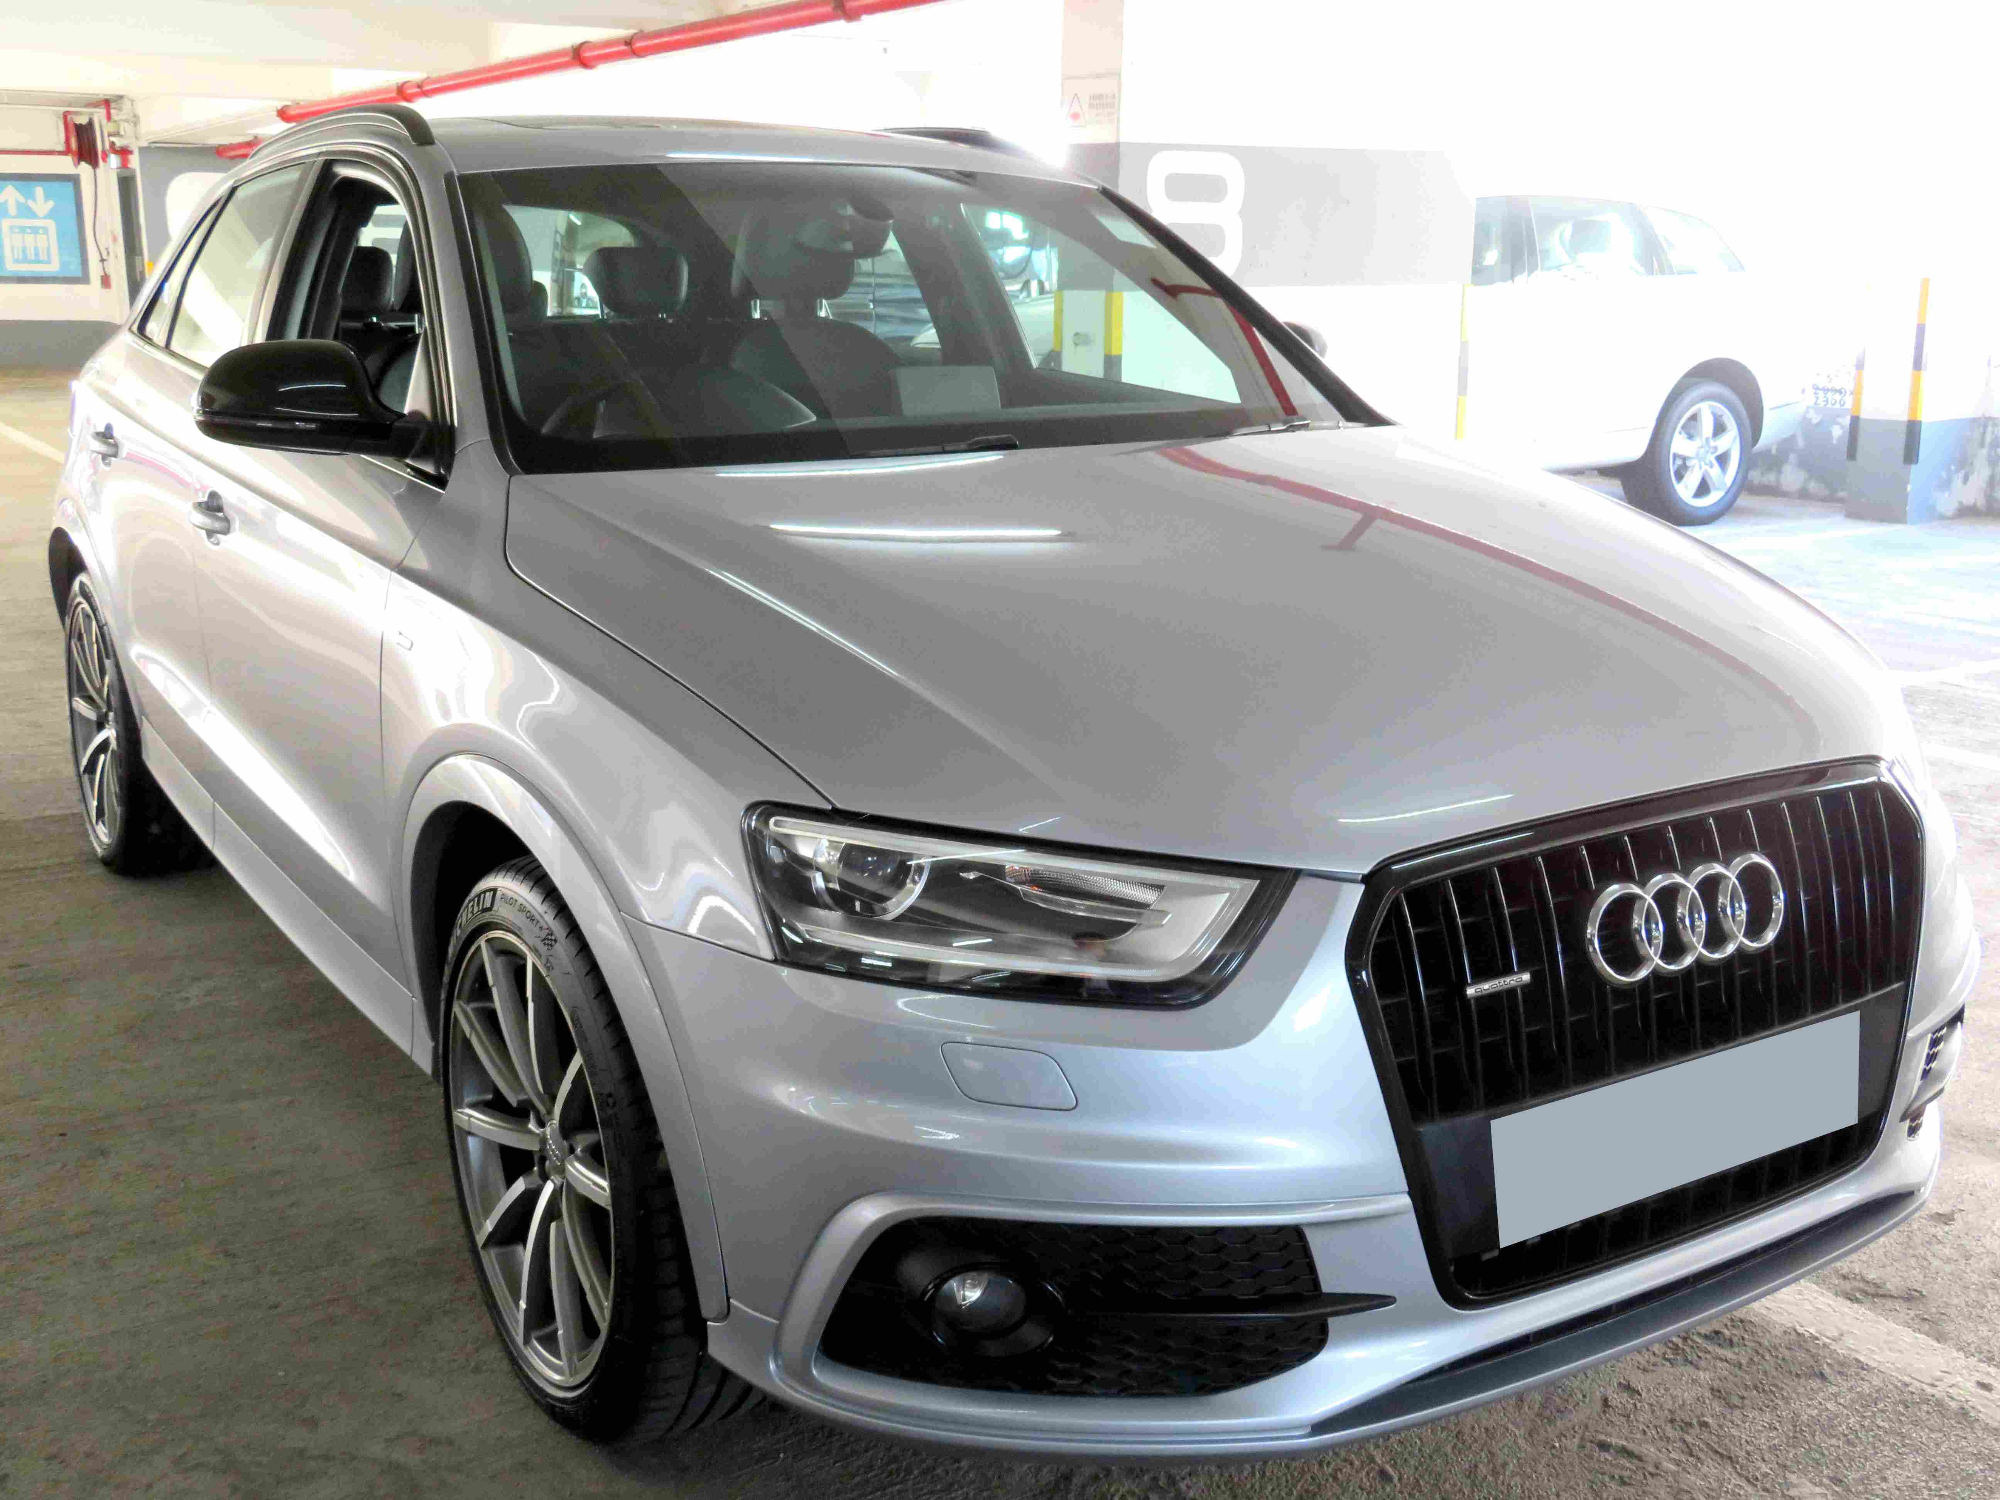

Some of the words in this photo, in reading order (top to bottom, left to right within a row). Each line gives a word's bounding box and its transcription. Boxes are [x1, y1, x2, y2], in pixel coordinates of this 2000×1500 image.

[1146, 149, 1245, 277] 8
[517, 903, 540, 927] SPORT
[1474, 976, 1524, 994] quattro
